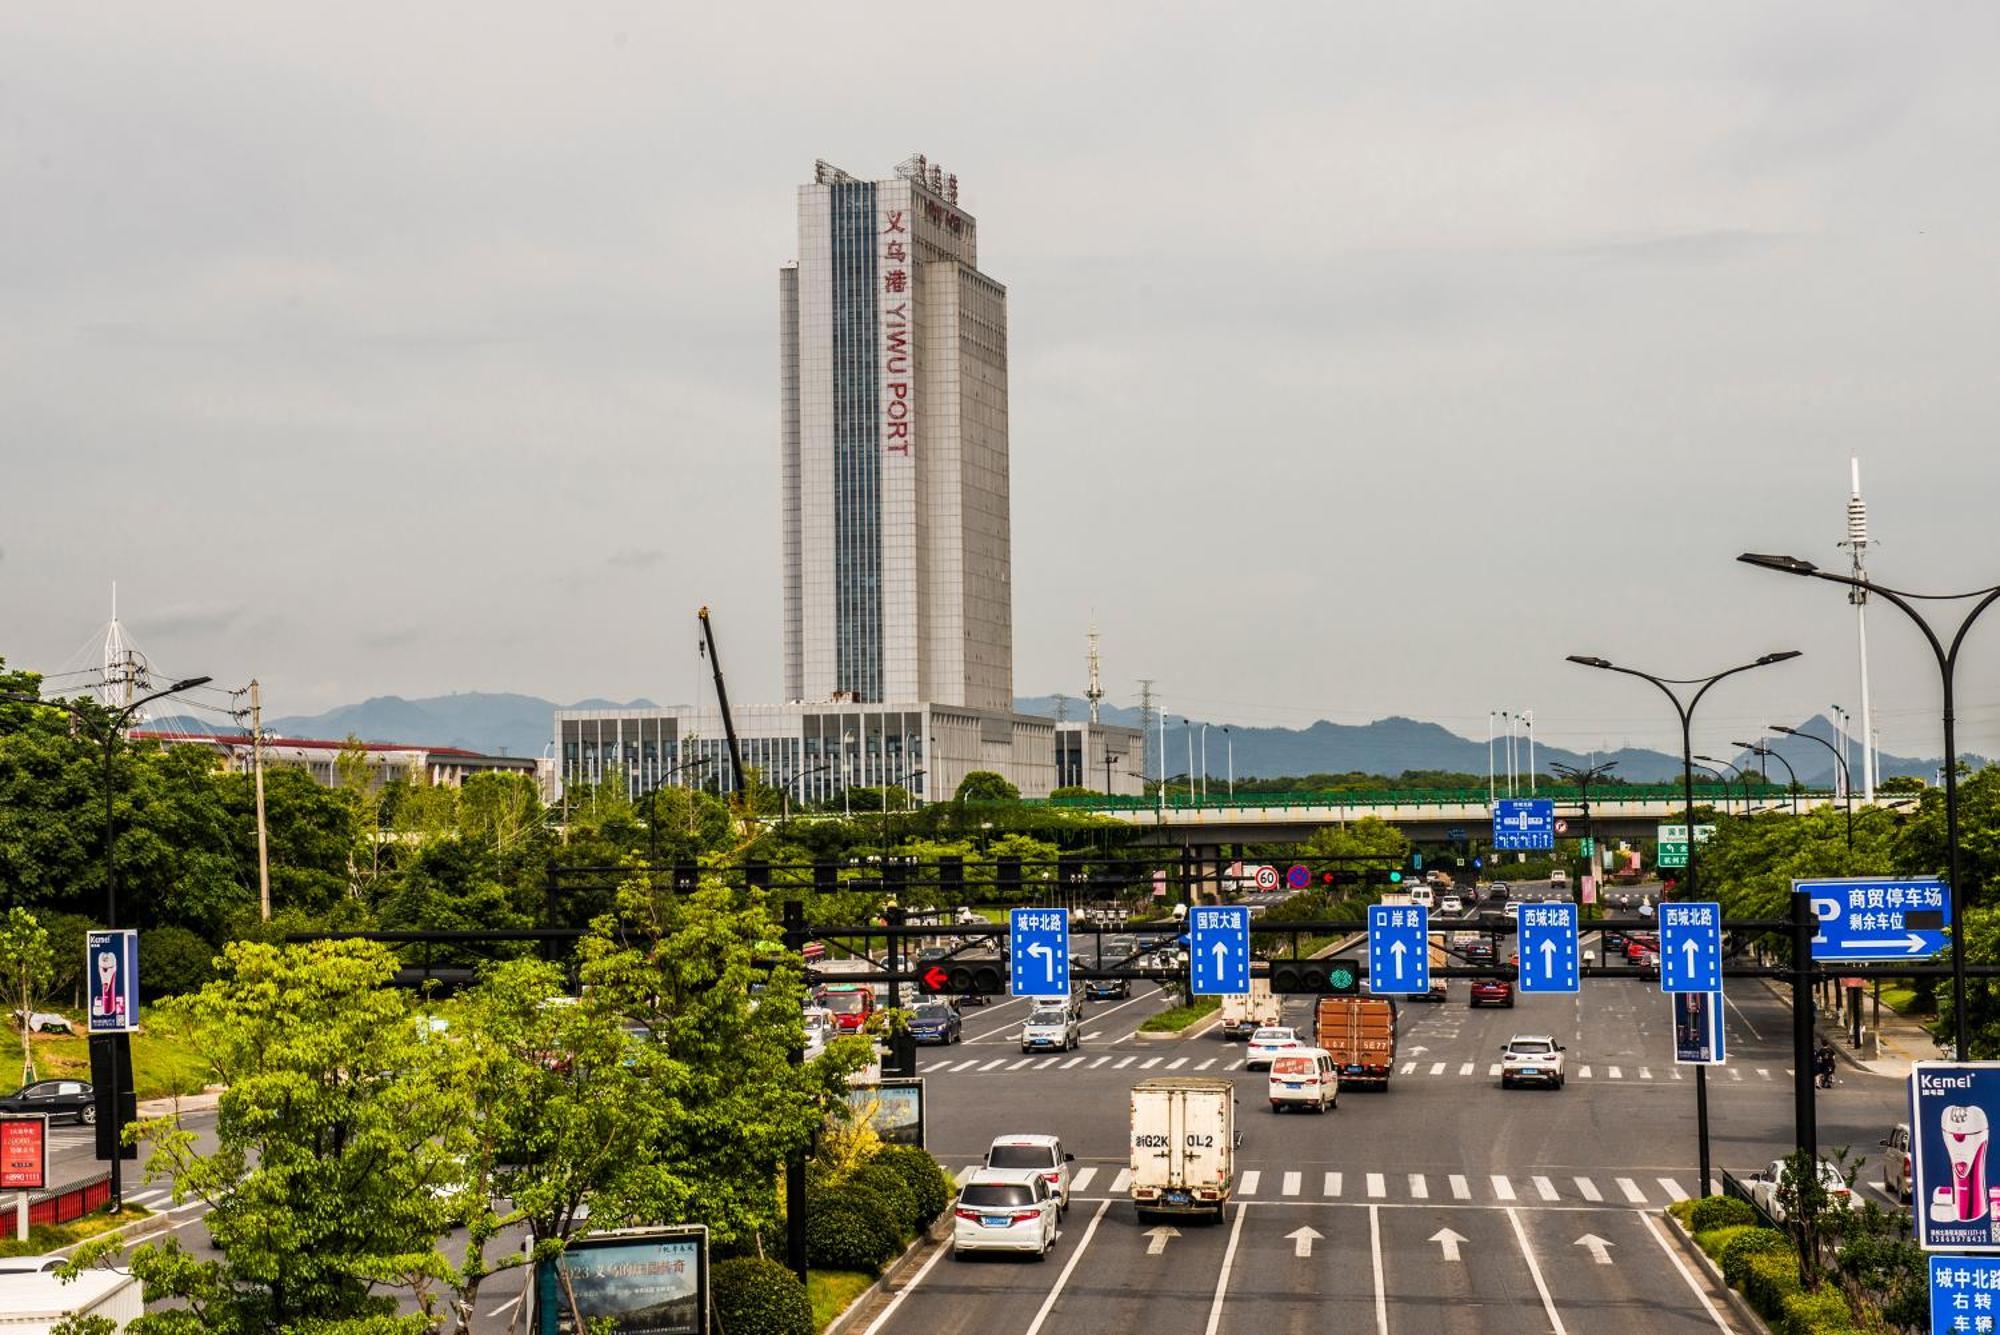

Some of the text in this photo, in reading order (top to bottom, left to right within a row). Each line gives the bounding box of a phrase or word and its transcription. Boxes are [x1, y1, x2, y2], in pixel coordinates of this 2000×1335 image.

[883, 209, 906, 293] 义乌港
[885, 302, 908, 456] YIWU PORT
[1259, 872, 1275, 885] 60
[1848, 887, 1942, 909] 商贸停车场
[1017, 913, 1062, 932] 城中北路
[1197, 911, 1242, 930] 国贸大道
[1376, 910, 1420, 928] 口岸路
[1524, 909, 1570, 927] 西城北路
[1666, 908, 1712, 926] 西城北路
[1849, 912, 1904, 931] 剩余车位
[1952, 1293, 1992, 1310] 右转
[1953, 1315, 1993, 1333] 车辆
